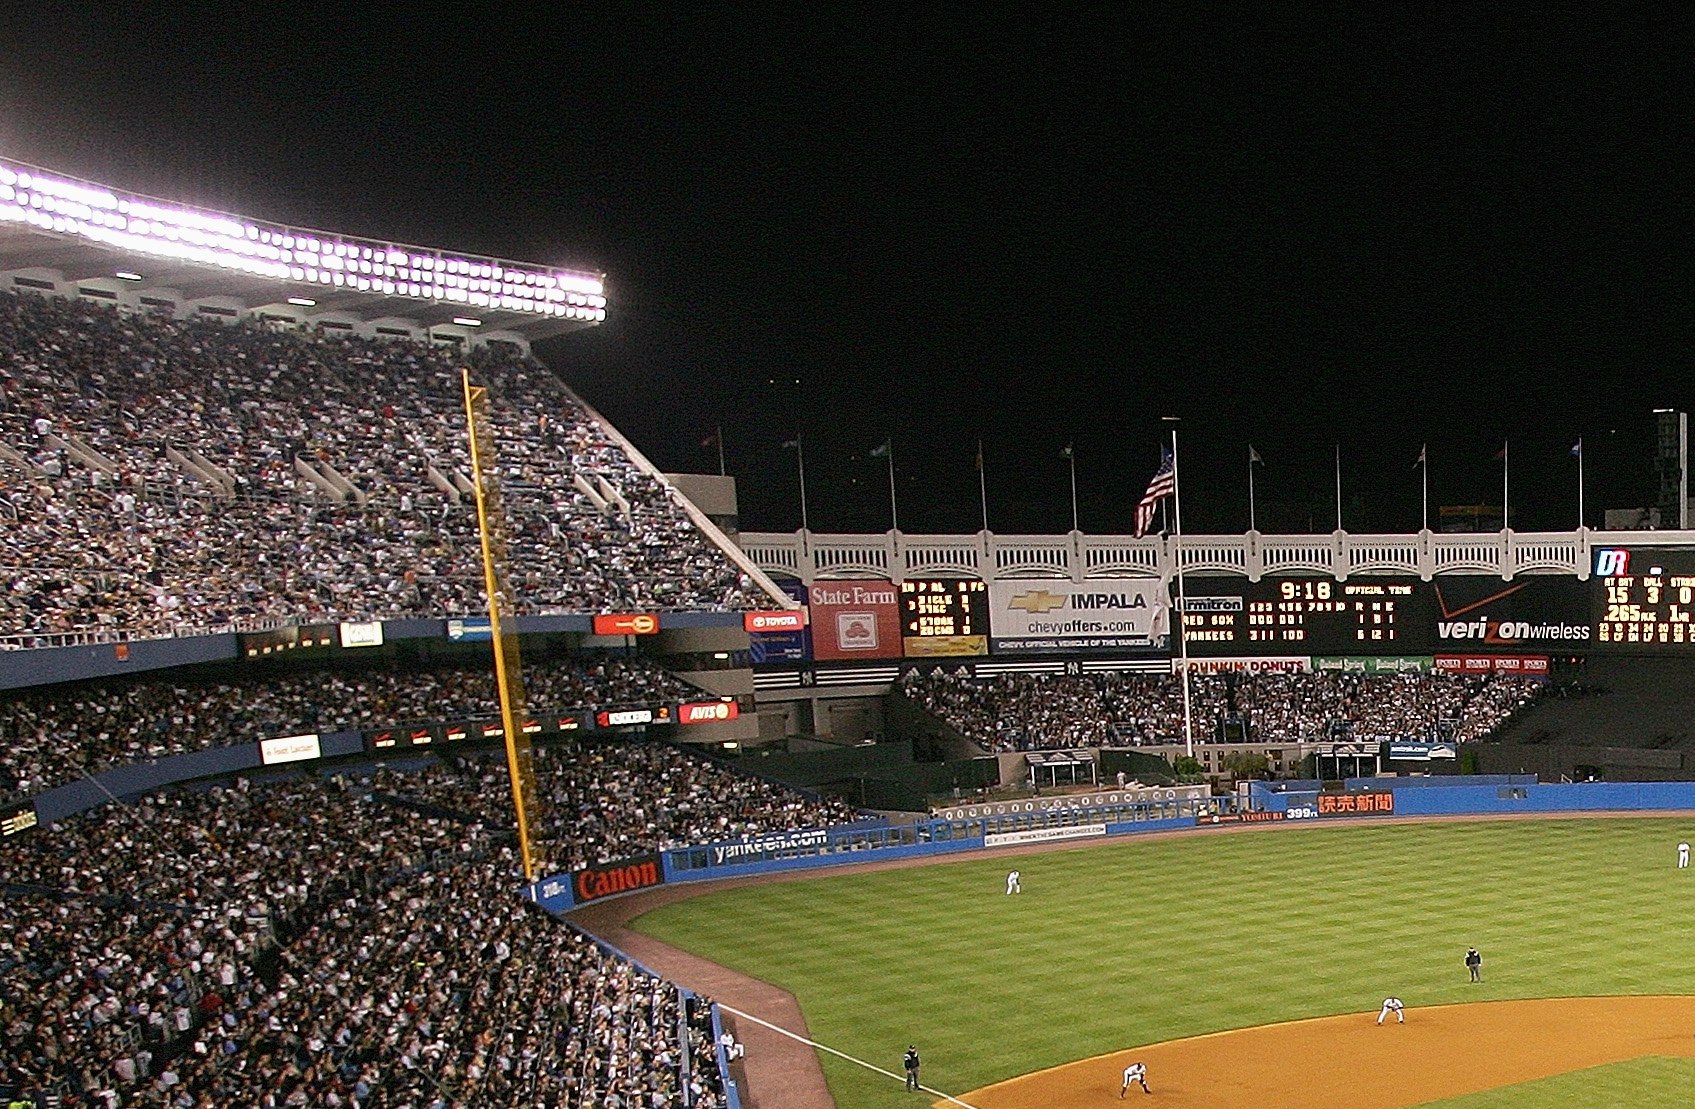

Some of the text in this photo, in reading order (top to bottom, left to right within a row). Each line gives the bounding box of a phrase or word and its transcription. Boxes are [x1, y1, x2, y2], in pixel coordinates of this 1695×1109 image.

[812, 587, 896, 605] State Farm
[1281, 581, 1331, 600] 9:18
[1345, 586, 1411, 594] OFFICIAL TIME
[1607, 586, 1628, 604] 15
[1647, 586, 1658, 604] 3
[1680, 586, 1692, 604] 0
[1072, 594, 1147, 609] IMPALA
[1355, 602, 1364, 611] R
[1386, 602, 1394, 611] E
[1182, 615, 1203, 625] RED
[1211, 615, 1234, 625] SOX
[1604, 604, 1640, 621] .265
[765, 616, 798, 625] TOYOTA
[1028, 620, 1135, 635] chevyoffers.com
[1184, 630, 1234, 641] YANKEES
[1438, 616, 1590, 644] verizon wireless
[1188, 661, 1304, 672] DUNKIN' DONUTS
[690, 706, 716, 720] AVIS
[715, 828, 827, 863] yankees.com
[578, 862, 657, 900] Canon
